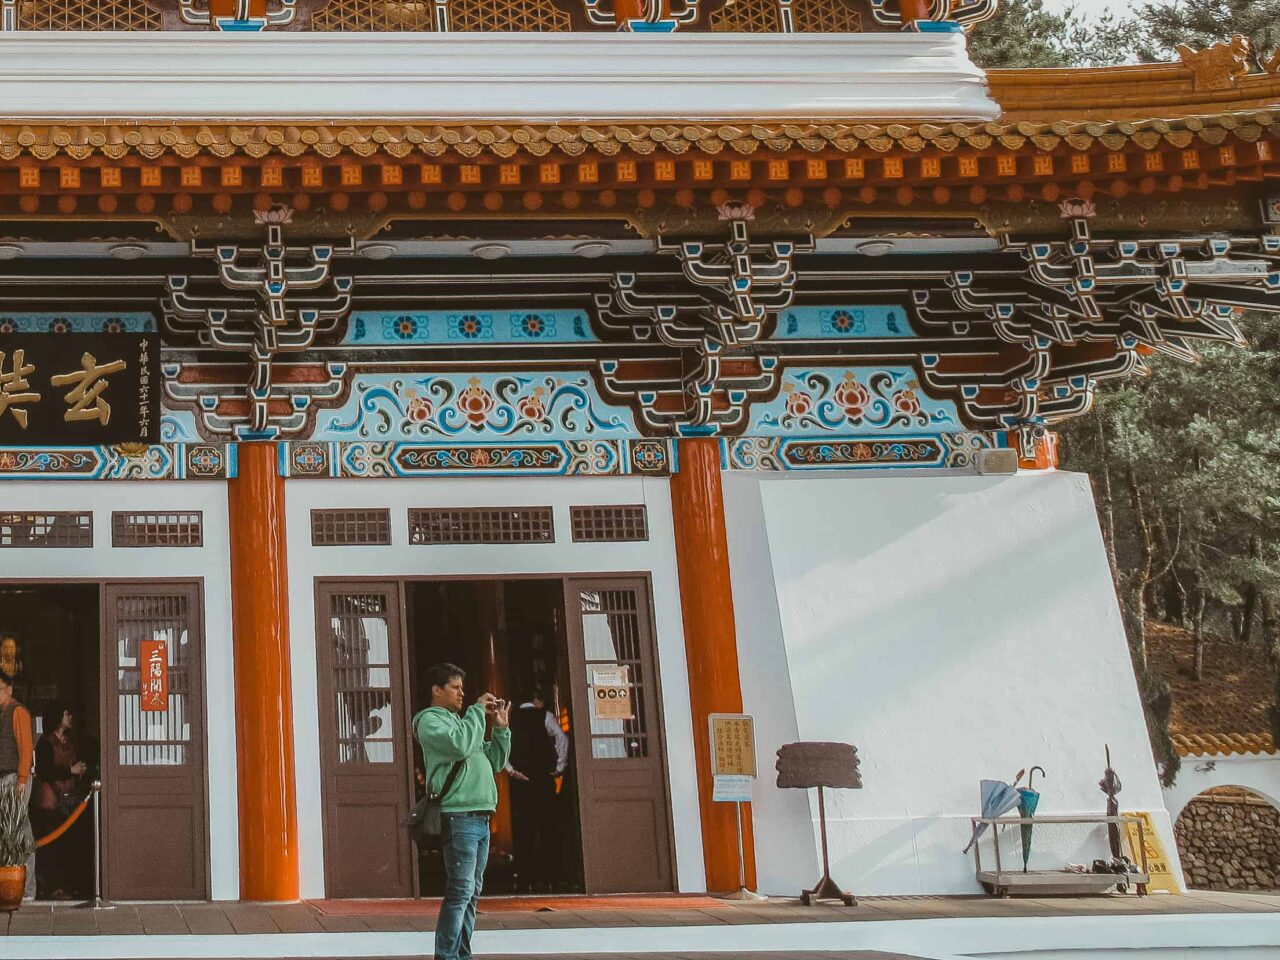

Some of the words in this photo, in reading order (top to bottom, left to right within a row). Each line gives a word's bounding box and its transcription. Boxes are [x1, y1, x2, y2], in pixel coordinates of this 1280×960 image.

[138, 339, 150, 438] 中華民國六十一年六月
[148, 649, 164, 706] 三陽開泰
